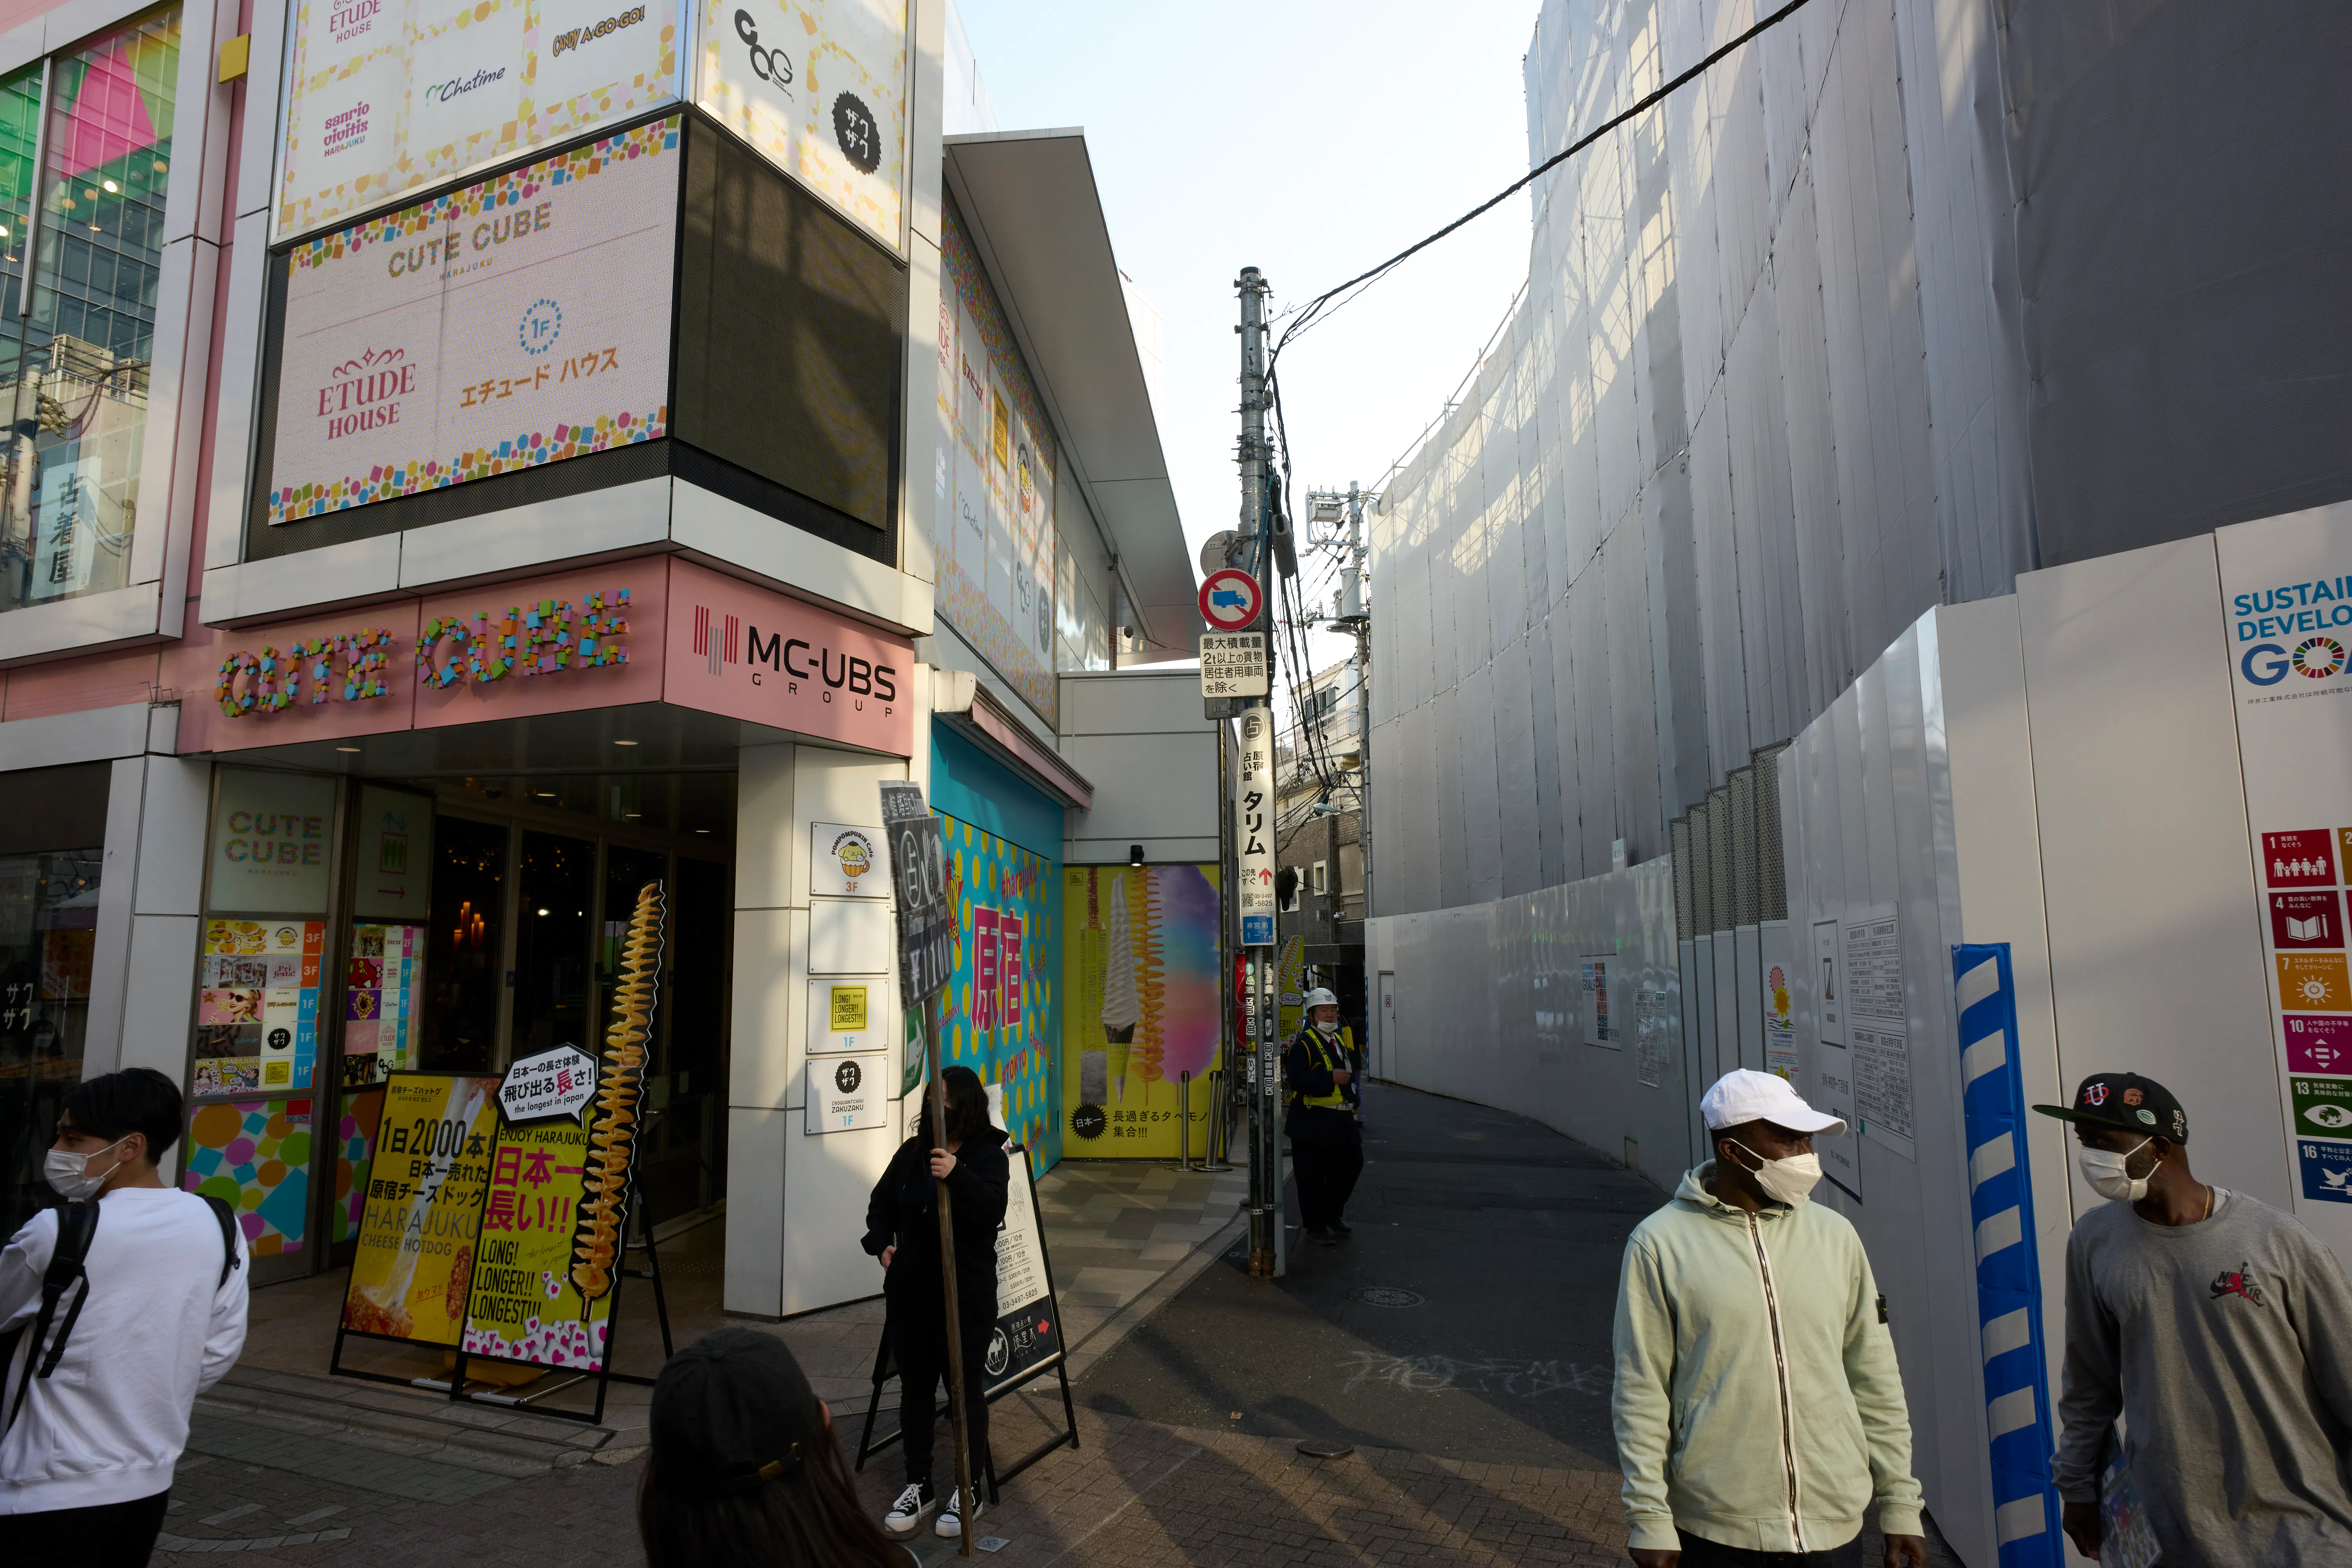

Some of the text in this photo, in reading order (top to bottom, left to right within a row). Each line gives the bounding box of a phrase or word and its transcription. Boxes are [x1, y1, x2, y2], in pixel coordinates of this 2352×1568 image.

[329, 0, 381, 33] ETUDE
[336, 21, 372, 44] HOUSE
[553, 29, 581, 57] CANDY
[440, 67, 506, 102] Chatime
[773, 80, 786, 93] CHICAGO
[325, 101, 370, 130] sanrio
[846, 108, 868, 139] ザク
[323, 120, 368, 146] vivitix
[324, 135, 365, 157] HARAJUKU
[846, 129, 868, 159] ザク
[388, 201, 551, 278] CUTE CUBE
[439, 258, 494, 281] HARAJUKU
[531, 315, 550, 339] 1F
[460, 347, 619, 408] エチュード ハウス
[967, 363, 983, 406] スピンズ
[318, 363, 417, 417] ETUDE
[328, 401, 401, 439] HOUSE
[964, 503, 983, 540] Chatime
[214, 588, 630, 719] CUTE CUBE
[1203, 637, 1262, 650] 最大積載量
[746, 626, 896, 703] MC-UBS
[1204, 651, 1263, 665] 2t以上の貨物
[1205, 666, 1263, 679] 居住者用車両
[751, 675, 893, 719] GROUP
[1205, 682, 1237, 693] を除く
[1246, 718, 1262, 736] 占
[1243, 751, 1252, 781] 占い館
[1253, 751, 1263, 771] 原宿
[228, 811, 323, 839] CUTE
[1243, 791, 1266, 856] タリム
[831, 831, 867, 855] POMPOMPURIN
[2269, 837, 2275, 849] 1
[2345, 832, 2352, 844] 2
[225, 839, 321, 866] CUBE
[846, 882, 858, 893] 3F
[1002, 857, 1037, 903] #harajuku
[1242, 877, 1255, 886] すぐ
[2276, 897, 2285, 909] 4
[306, 933, 320, 942] 3F
[304, 966, 318, 975] 3F
[403, 969, 409, 977] 1F
[971, 904, 1022, 1034] 原宿
[2282, 958, 2289, 970] 7
[6, 982, 34, 1004] ザク
[1582, 979, 1595, 991] GOALS
[303, 999, 314, 1008] 1F
[401, 999, 407, 1007] 1F
[835, 995, 850, 1004] LONG!
[835, 1004, 858, 1013] LONGER!!
[3, 1007, 31, 1031] ザク
[835, 1014, 863, 1023] LONGEST!!!
[1246, 1017, 1256, 1035] CROD
[2289, 1020, 2304, 1033] 10
[300, 1033, 311, 1042] 1F
[399, 1029, 405, 1038] 1F
[844, 1037, 854, 1047] 1F
[1264, 1042, 1273, 1060] CROD
[298, 1067, 309, 1076] 1F
[513, 1055, 580, 1079] 日本一の長さ体験
[842, 1069, 855, 1077] ザク
[1002, 1047, 1026, 1088] #TOKYO
[391, 1085, 442, 1096] 原宿チーズハットグ
[504, 1068, 593, 1103] 飛び出る長さ!
[842, 1077, 855, 1085] ザク
[1265, 1077, 1274, 1096] CROD
[2295, 1082, 2310, 1094] 13
[514, 1103, 526, 1114] the
[527, 1098, 552, 1112] longest
[563, 1093, 584, 1106] japan
[831, 1104, 864, 1113] ZAKUZAKU
[844, 1115, 853, 1126] 1F
[1076, 1116, 1102, 1128] 日本一
[381, 1118, 493, 1160] 1日2000本!
[499, 1128, 589, 1146] ENJOY HARAJUKU
[1113, 1126, 1147, 1138] 集合!!!
[2303, 1145, 2317, 1158] 16
[408, 1160, 487, 1184] 日本一売れた
[493, 1146, 584, 1190] 日本一
[369, 1180, 486, 1207] 原宿チーズドッグ
[484, 1189, 571, 1234] 長い!!
[365, 1204, 480, 1240] HARAJUKU
[362, 1234, 452, 1256] CHEESE HOTDOG
[481, 1239, 519, 1265] LONG!
[550, 1251, 570, 1270] japan
[416, 1284, 443, 1301] 激ウマ!!
[476, 1269, 534, 1296] LONGER!!
[1003, 1288, 1038, 1309] 03-3497-5825
[472, 1298, 542, 1325] LONGEST!!!
[1011, 1315, 1031, 1331] 原宿占い館
[1013, 1327, 1036, 1347] 塔里木
